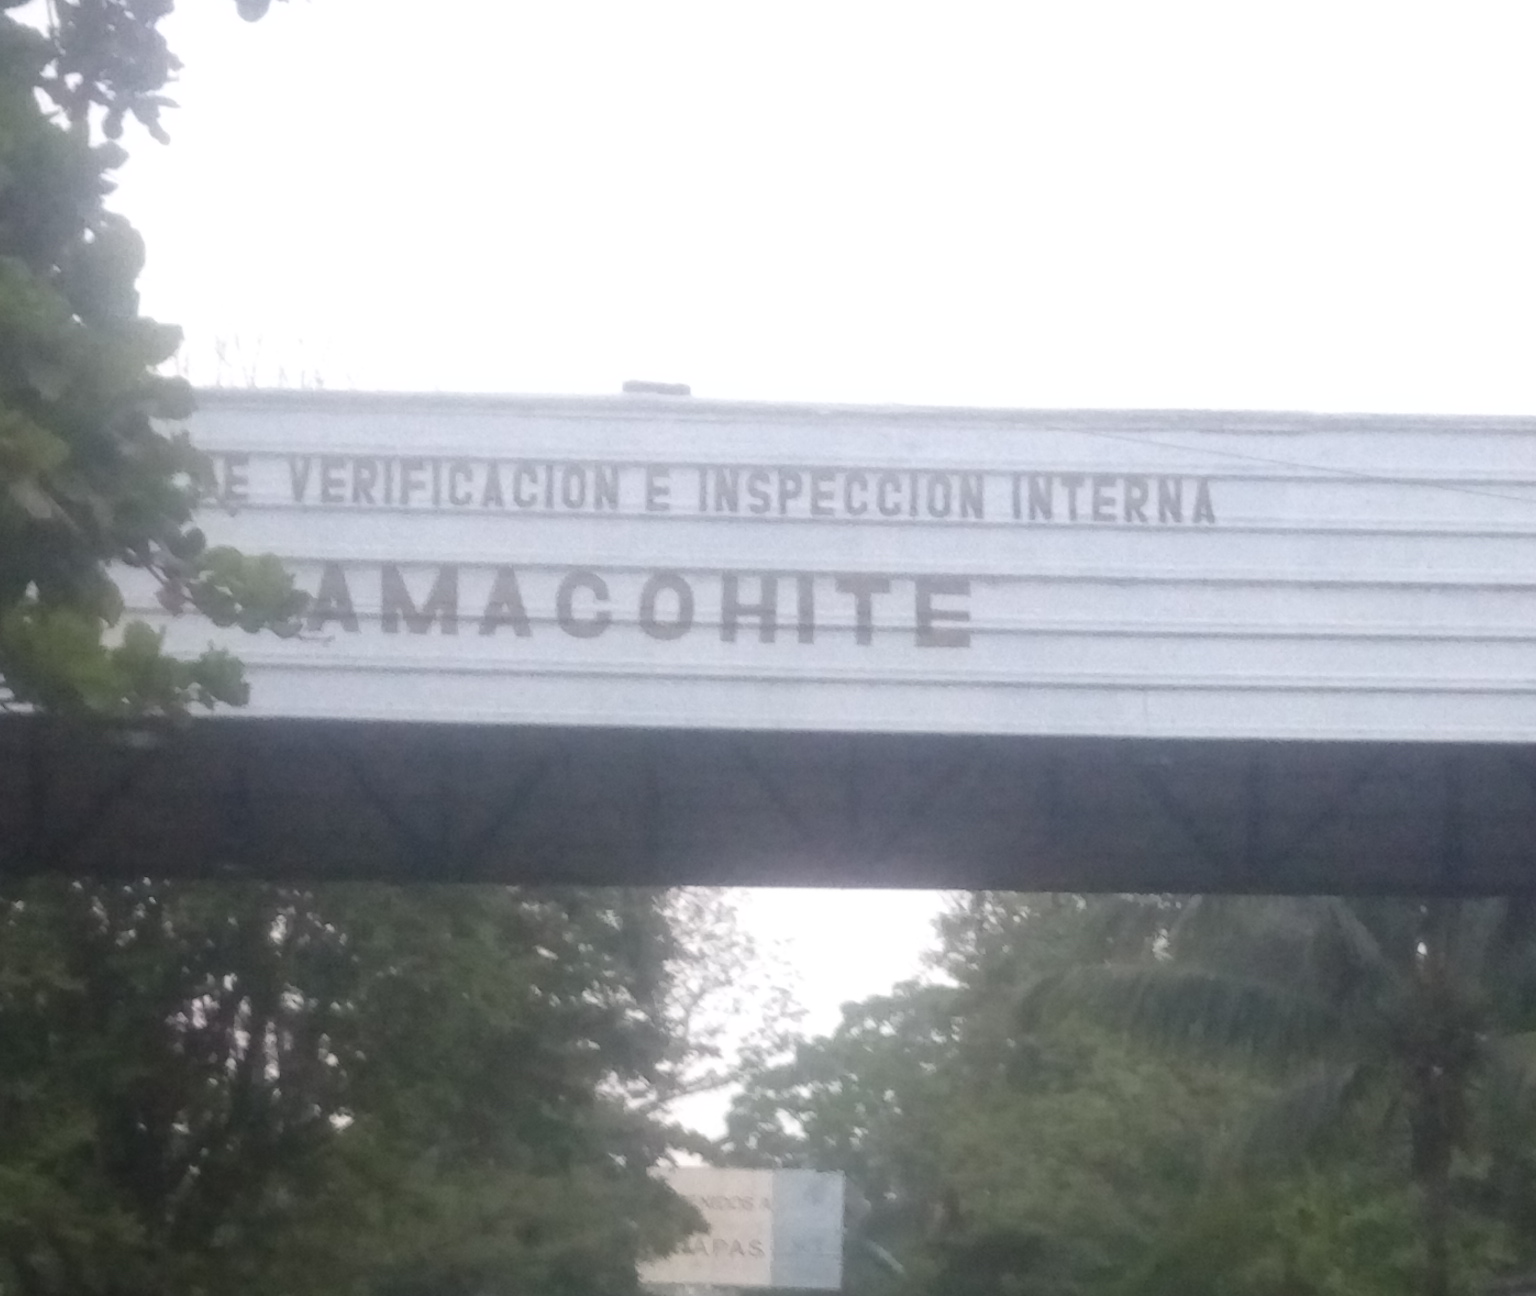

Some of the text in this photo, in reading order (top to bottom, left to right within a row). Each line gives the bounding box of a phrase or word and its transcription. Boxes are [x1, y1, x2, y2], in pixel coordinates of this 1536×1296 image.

[288, 454, 619, 510] VERIFICACION
[645, 463, 670, 512] E
[698, 465, 984, 519] INSPECCION
[1012, 470, 1216, 524] INTERNA
[306, 562, 971, 649] AMACOHITE
